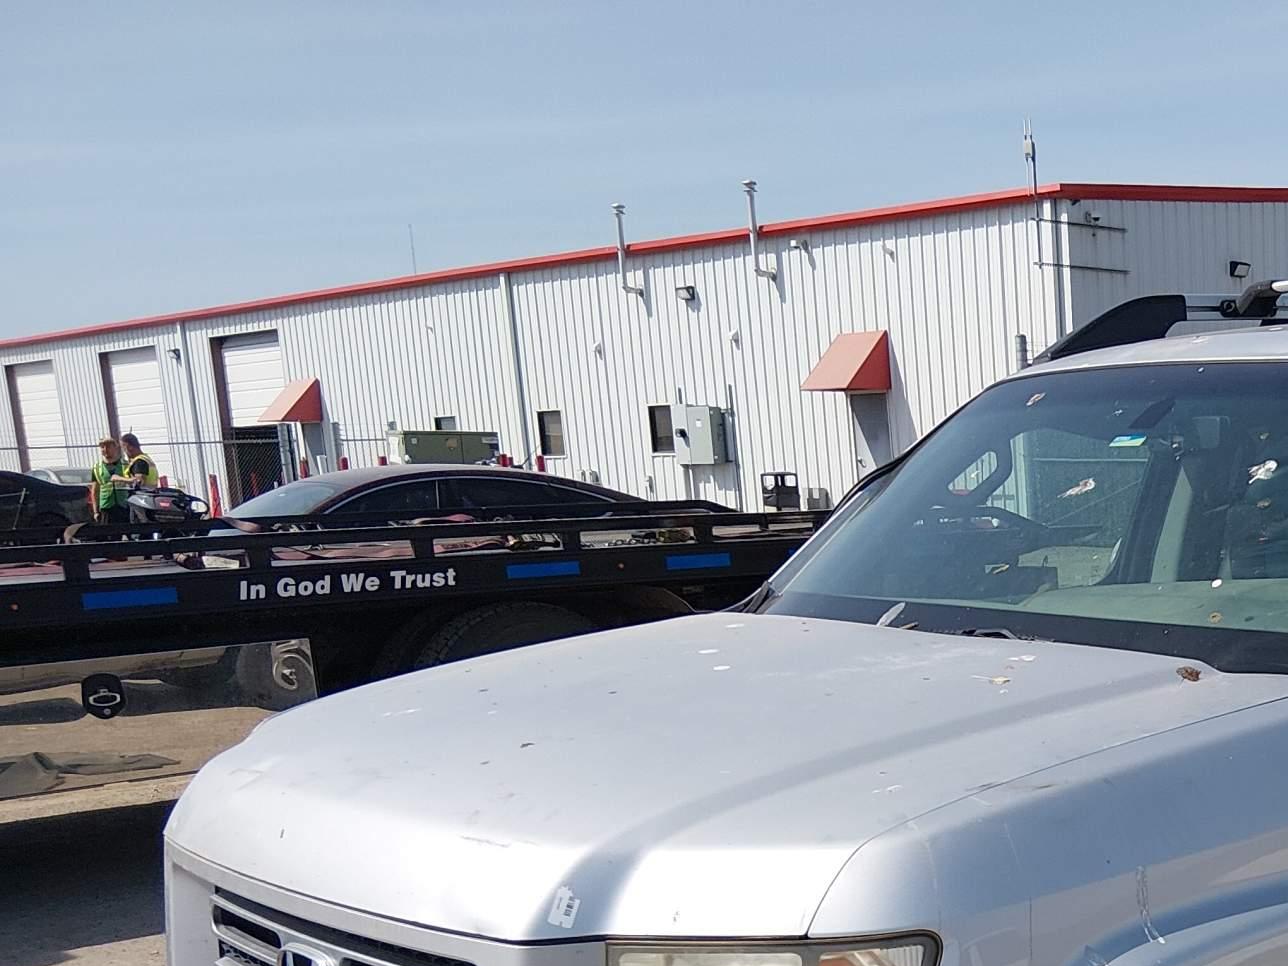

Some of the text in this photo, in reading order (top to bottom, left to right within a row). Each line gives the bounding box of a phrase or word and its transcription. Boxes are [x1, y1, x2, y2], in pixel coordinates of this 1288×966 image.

[239, 568, 456, 600] In God We Trust
